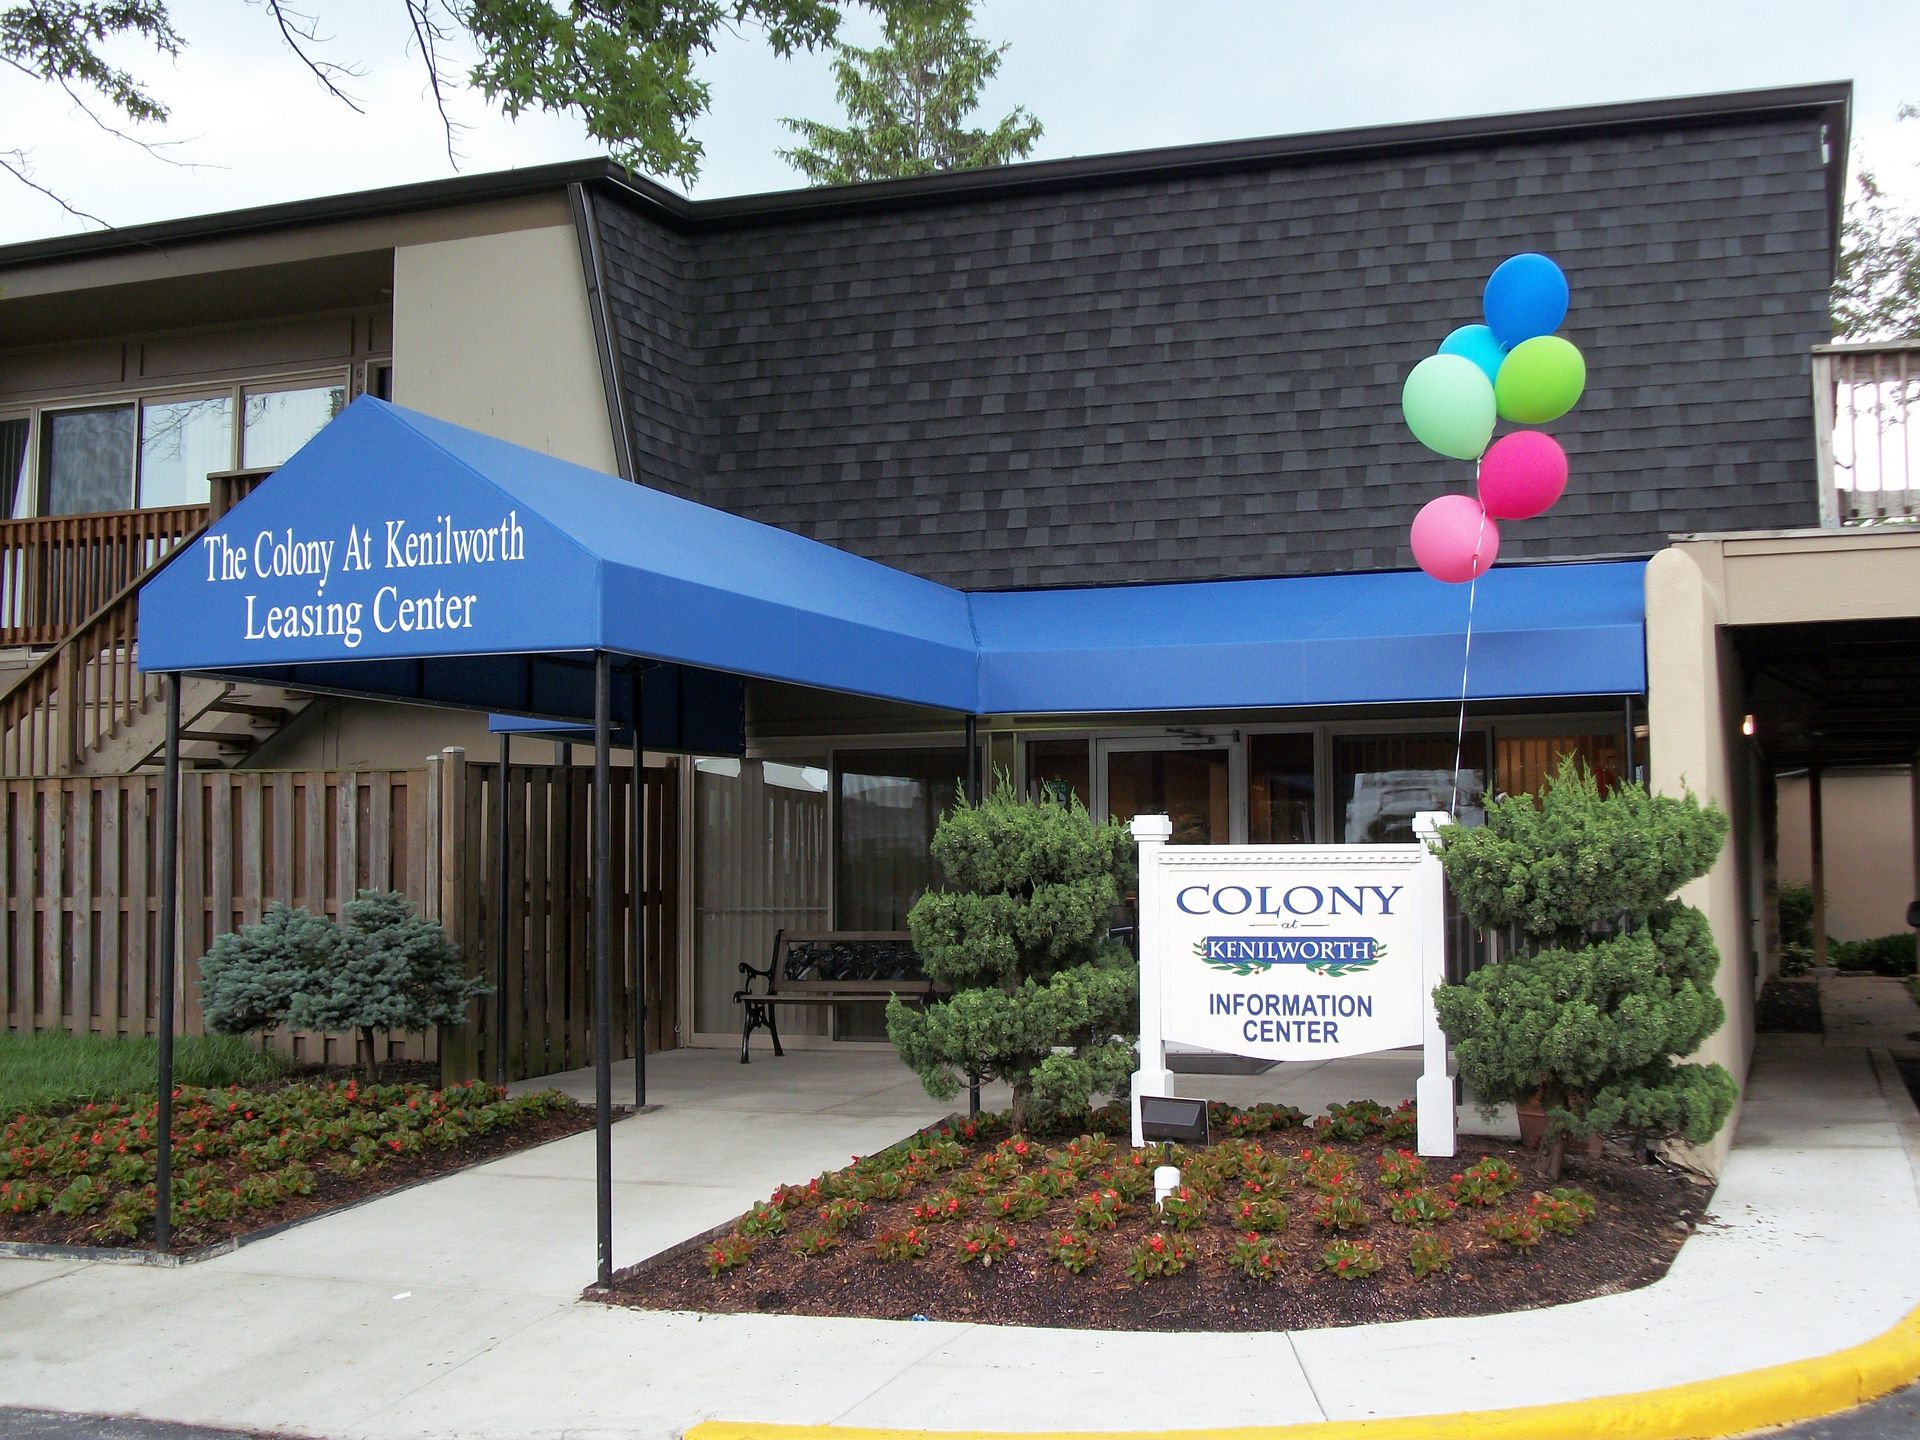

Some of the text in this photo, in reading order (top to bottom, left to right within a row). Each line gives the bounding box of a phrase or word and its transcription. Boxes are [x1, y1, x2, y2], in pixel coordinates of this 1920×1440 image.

[203, 509, 525, 588] The Colony At Kenilworth
[243, 585, 477, 648] Leasing Center
[1176, 884, 1404, 918] COLONY
[1281, 919, 1299, 929] at
[1209, 940, 1370, 961] KENILWORTH
[1209, 993, 1372, 1017] INFORMATION
[1243, 1019, 1339, 1043] CENTER
